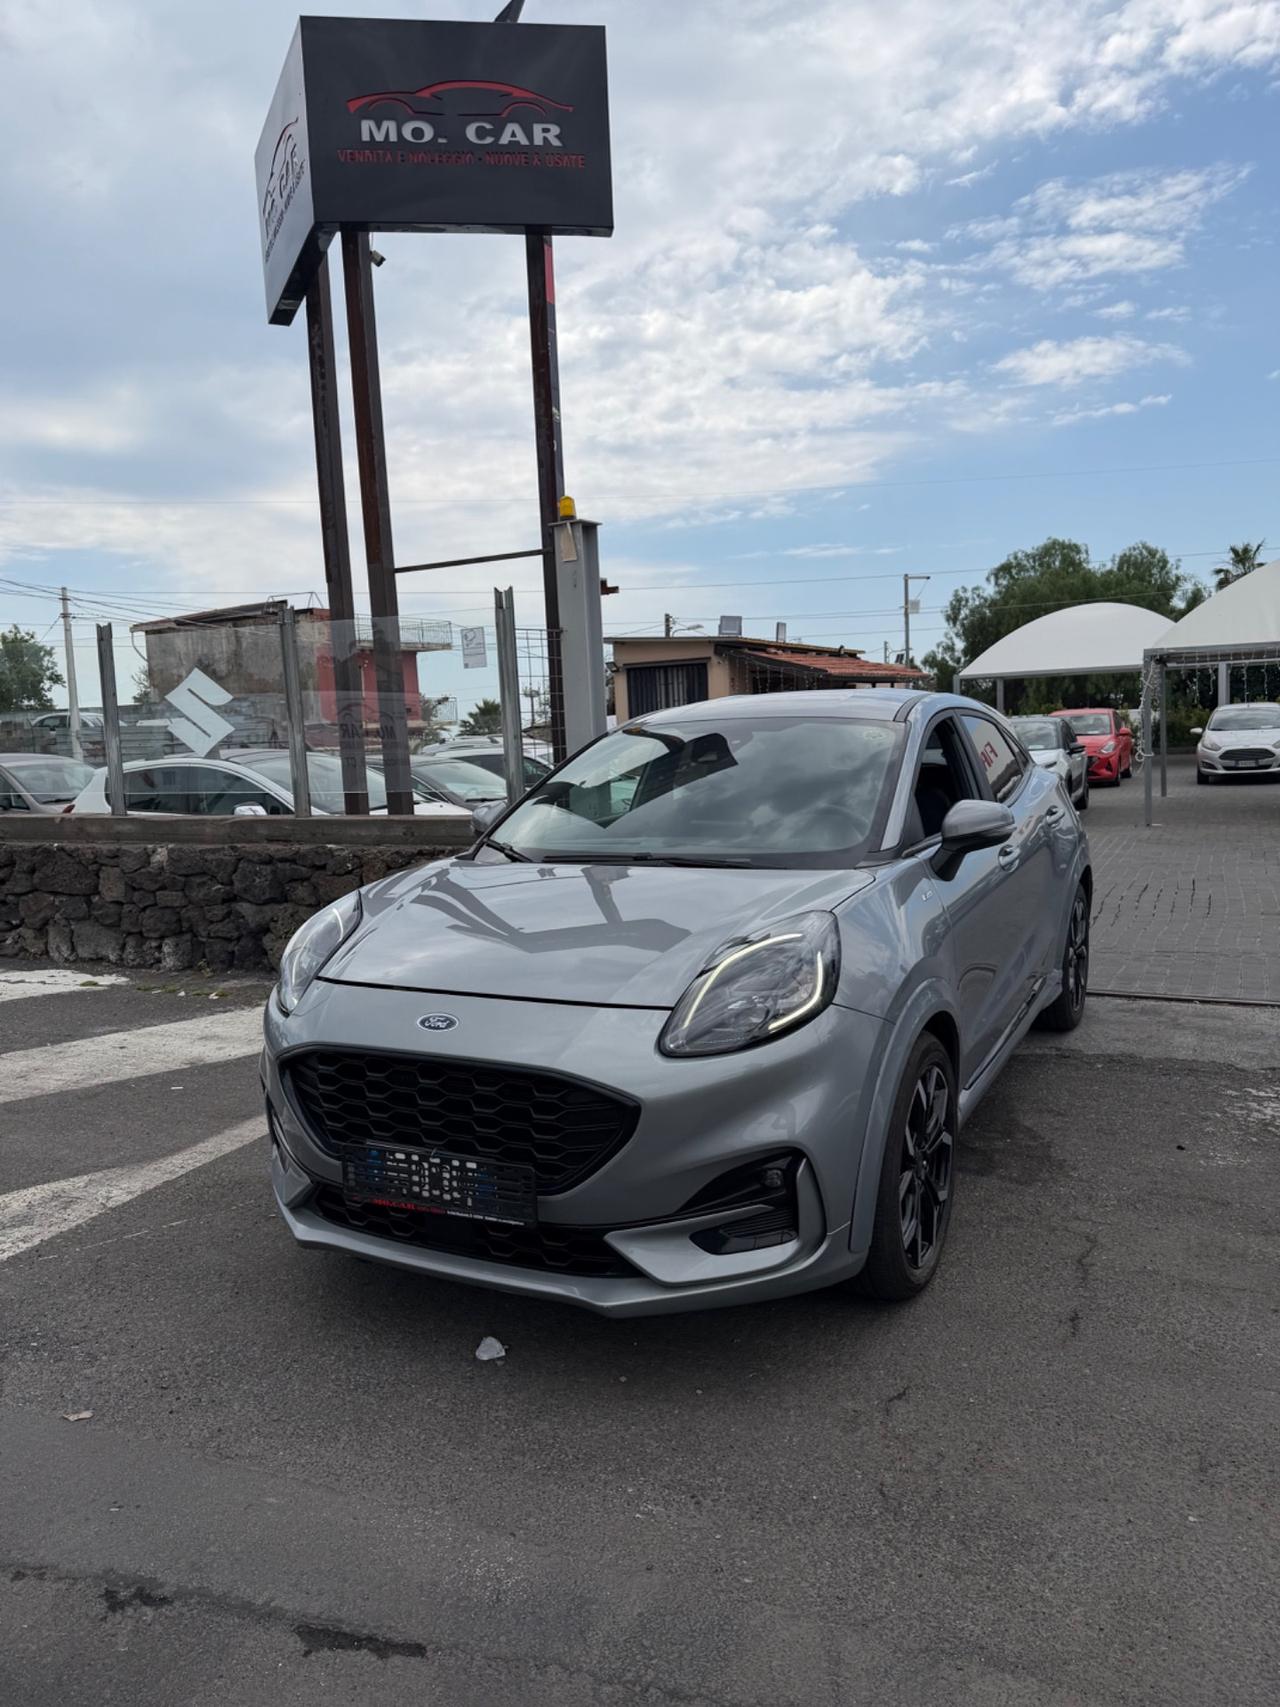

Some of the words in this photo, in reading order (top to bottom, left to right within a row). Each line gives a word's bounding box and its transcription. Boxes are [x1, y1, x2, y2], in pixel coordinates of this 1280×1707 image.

[360, 119, 448, 144] MO.
[465, 121, 563, 147] CAR
[337, 149, 393, 164] VENDITA
[485, 152, 529, 167] NUOVE
[545, 153, 586, 169] USATE
